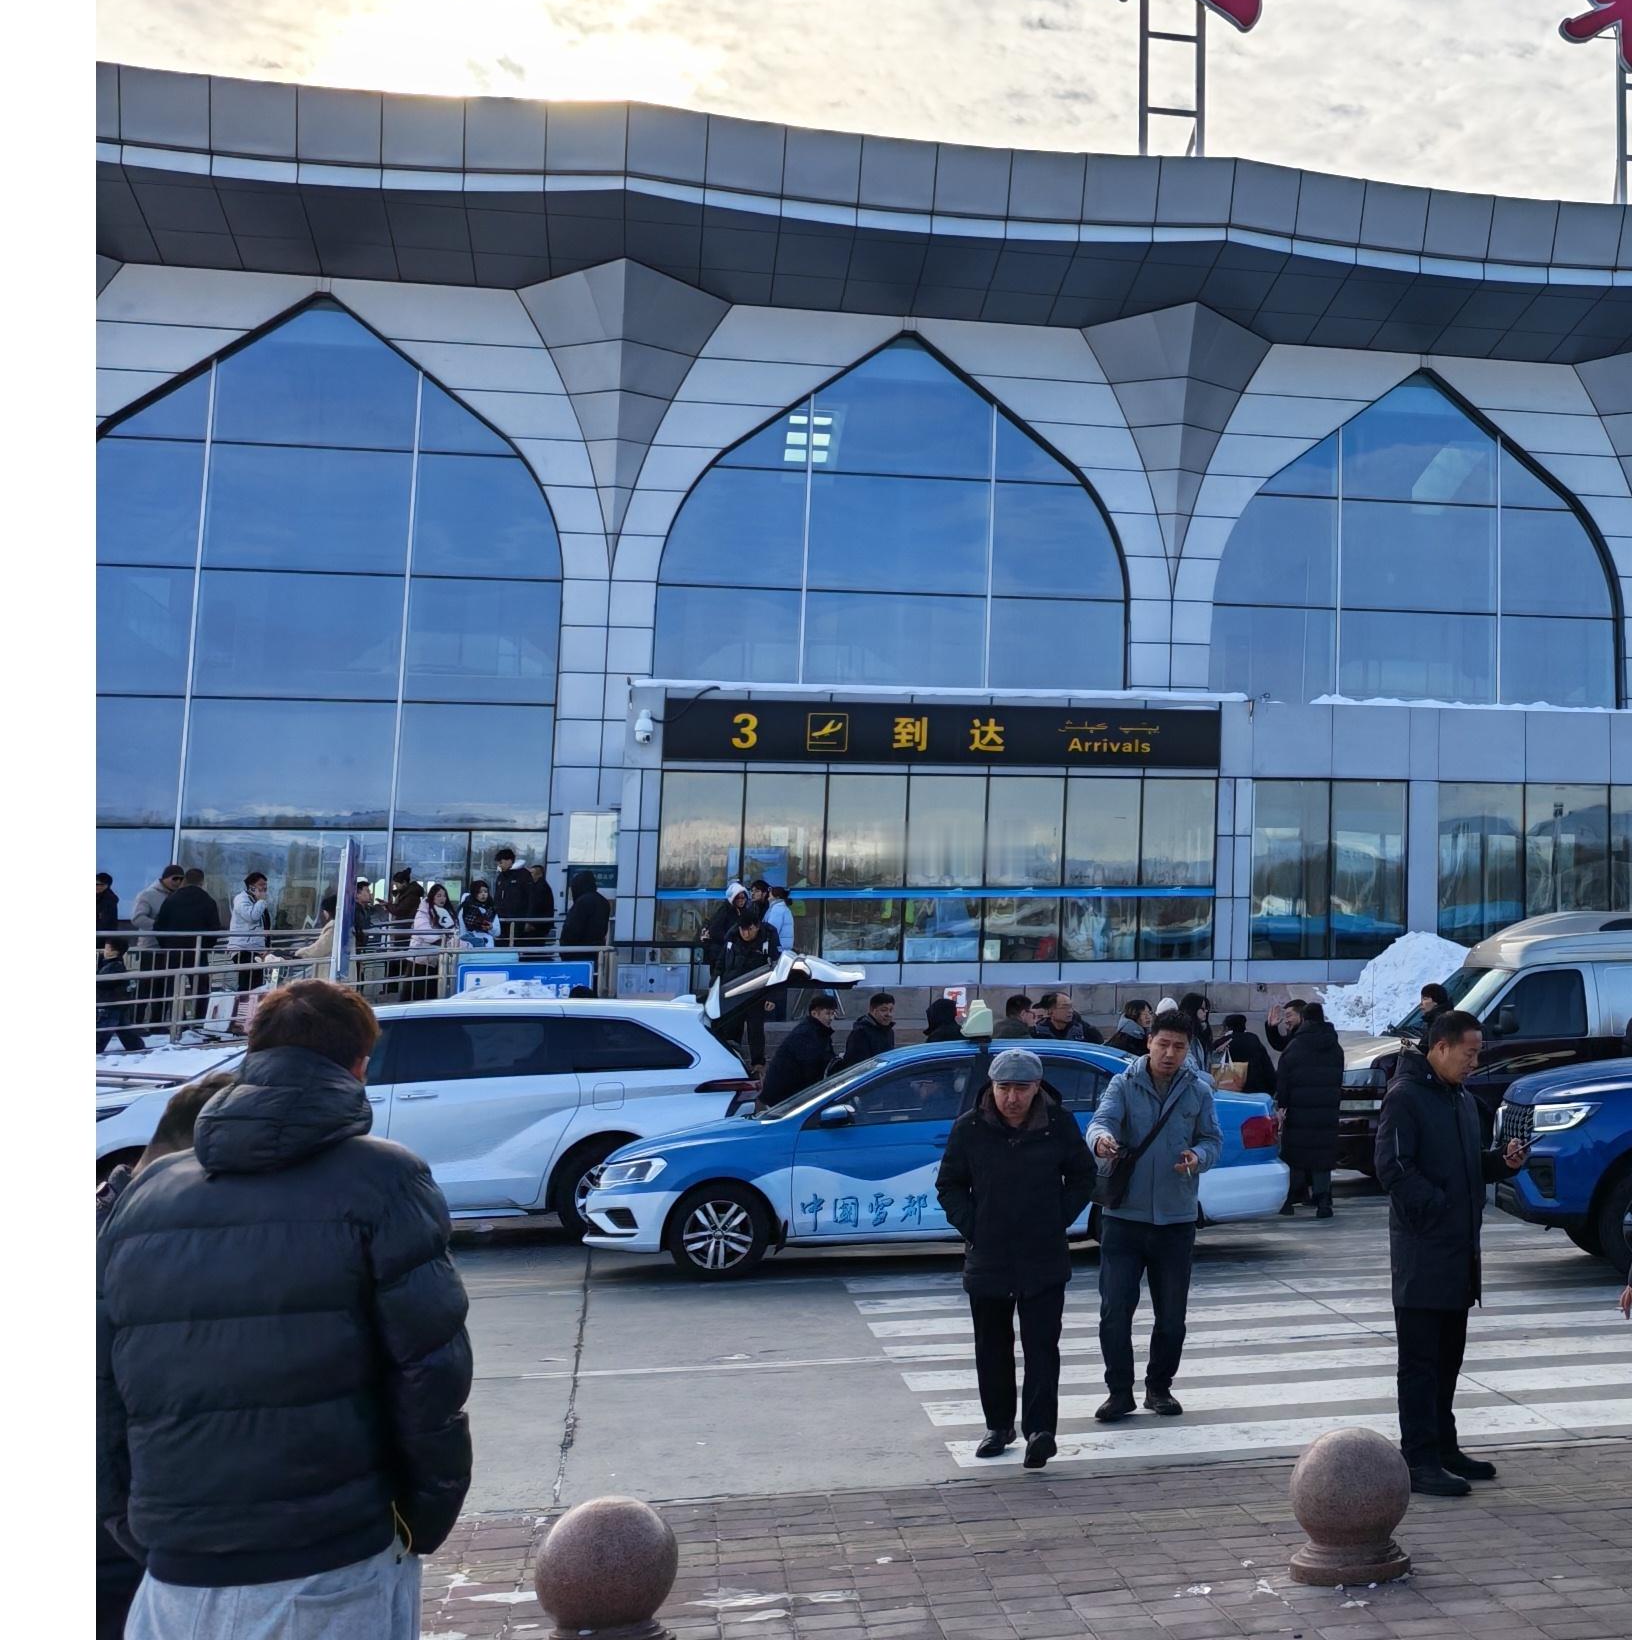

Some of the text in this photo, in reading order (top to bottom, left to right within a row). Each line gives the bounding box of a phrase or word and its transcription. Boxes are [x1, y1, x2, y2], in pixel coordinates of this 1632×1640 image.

[731, 713, 759, 749] 3
[892, 716, 1005, 751] 到达
[1068, 738, 1151, 753] Arrivals
